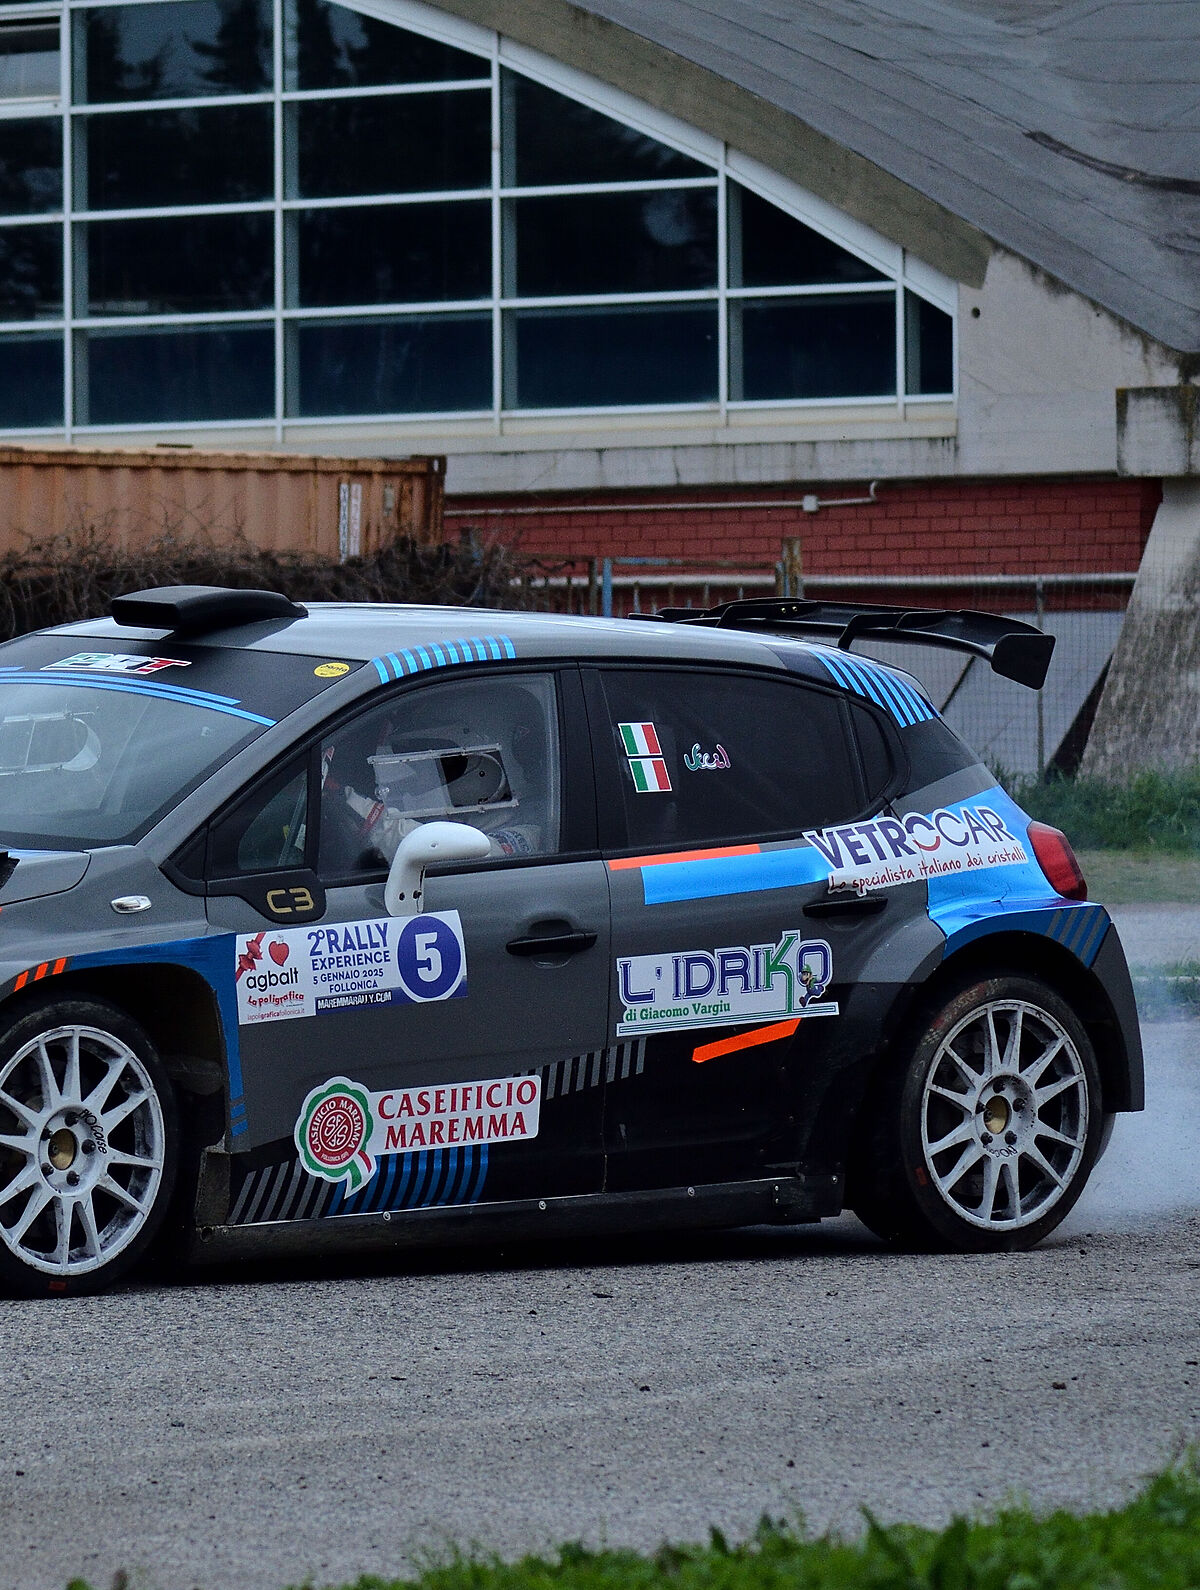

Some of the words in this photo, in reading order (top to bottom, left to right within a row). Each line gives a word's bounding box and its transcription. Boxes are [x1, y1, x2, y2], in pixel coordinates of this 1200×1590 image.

[807, 807, 1016, 869] VETROCAR
[829, 875, 847, 891] Lo
[851, 864, 915, 893] specialista
[917, 858, 962, 877] italiano
[966, 852, 984, 868] dei
[987, 847, 1027, 866] cristalli
[266, 887, 315, 914] C3
[325, 922, 389, 954] RALLY
[311, 950, 391, 971] EXPERIENCE
[414, 931, 443, 983] 5
[246, 967, 299, 992] agbalt
[313, 975, 319, 985] 5
[320, 969, 360, 983] GENNAIO
[362, 967, 384, 979] 2025
[329, 979, 378, 994] FOLLONICA
[257, 990, 305, 1008] poligrafica
[625, 1007, 637, 1022] di
[639, 1004, 690, 1020] Giacomo
[691, 1000, 731, 1017] Vargiu
[247, 1008, 305, 1022] lapoligraficafollonica.it
[377, 1079, 537, 1120] CASEIFICIO
[310, 1100, 337, 1153] CASEIFICIO
[339, 1099, 362, 1150] MAREMMA
[384, 1111, 527, 1150] MAREMMA
